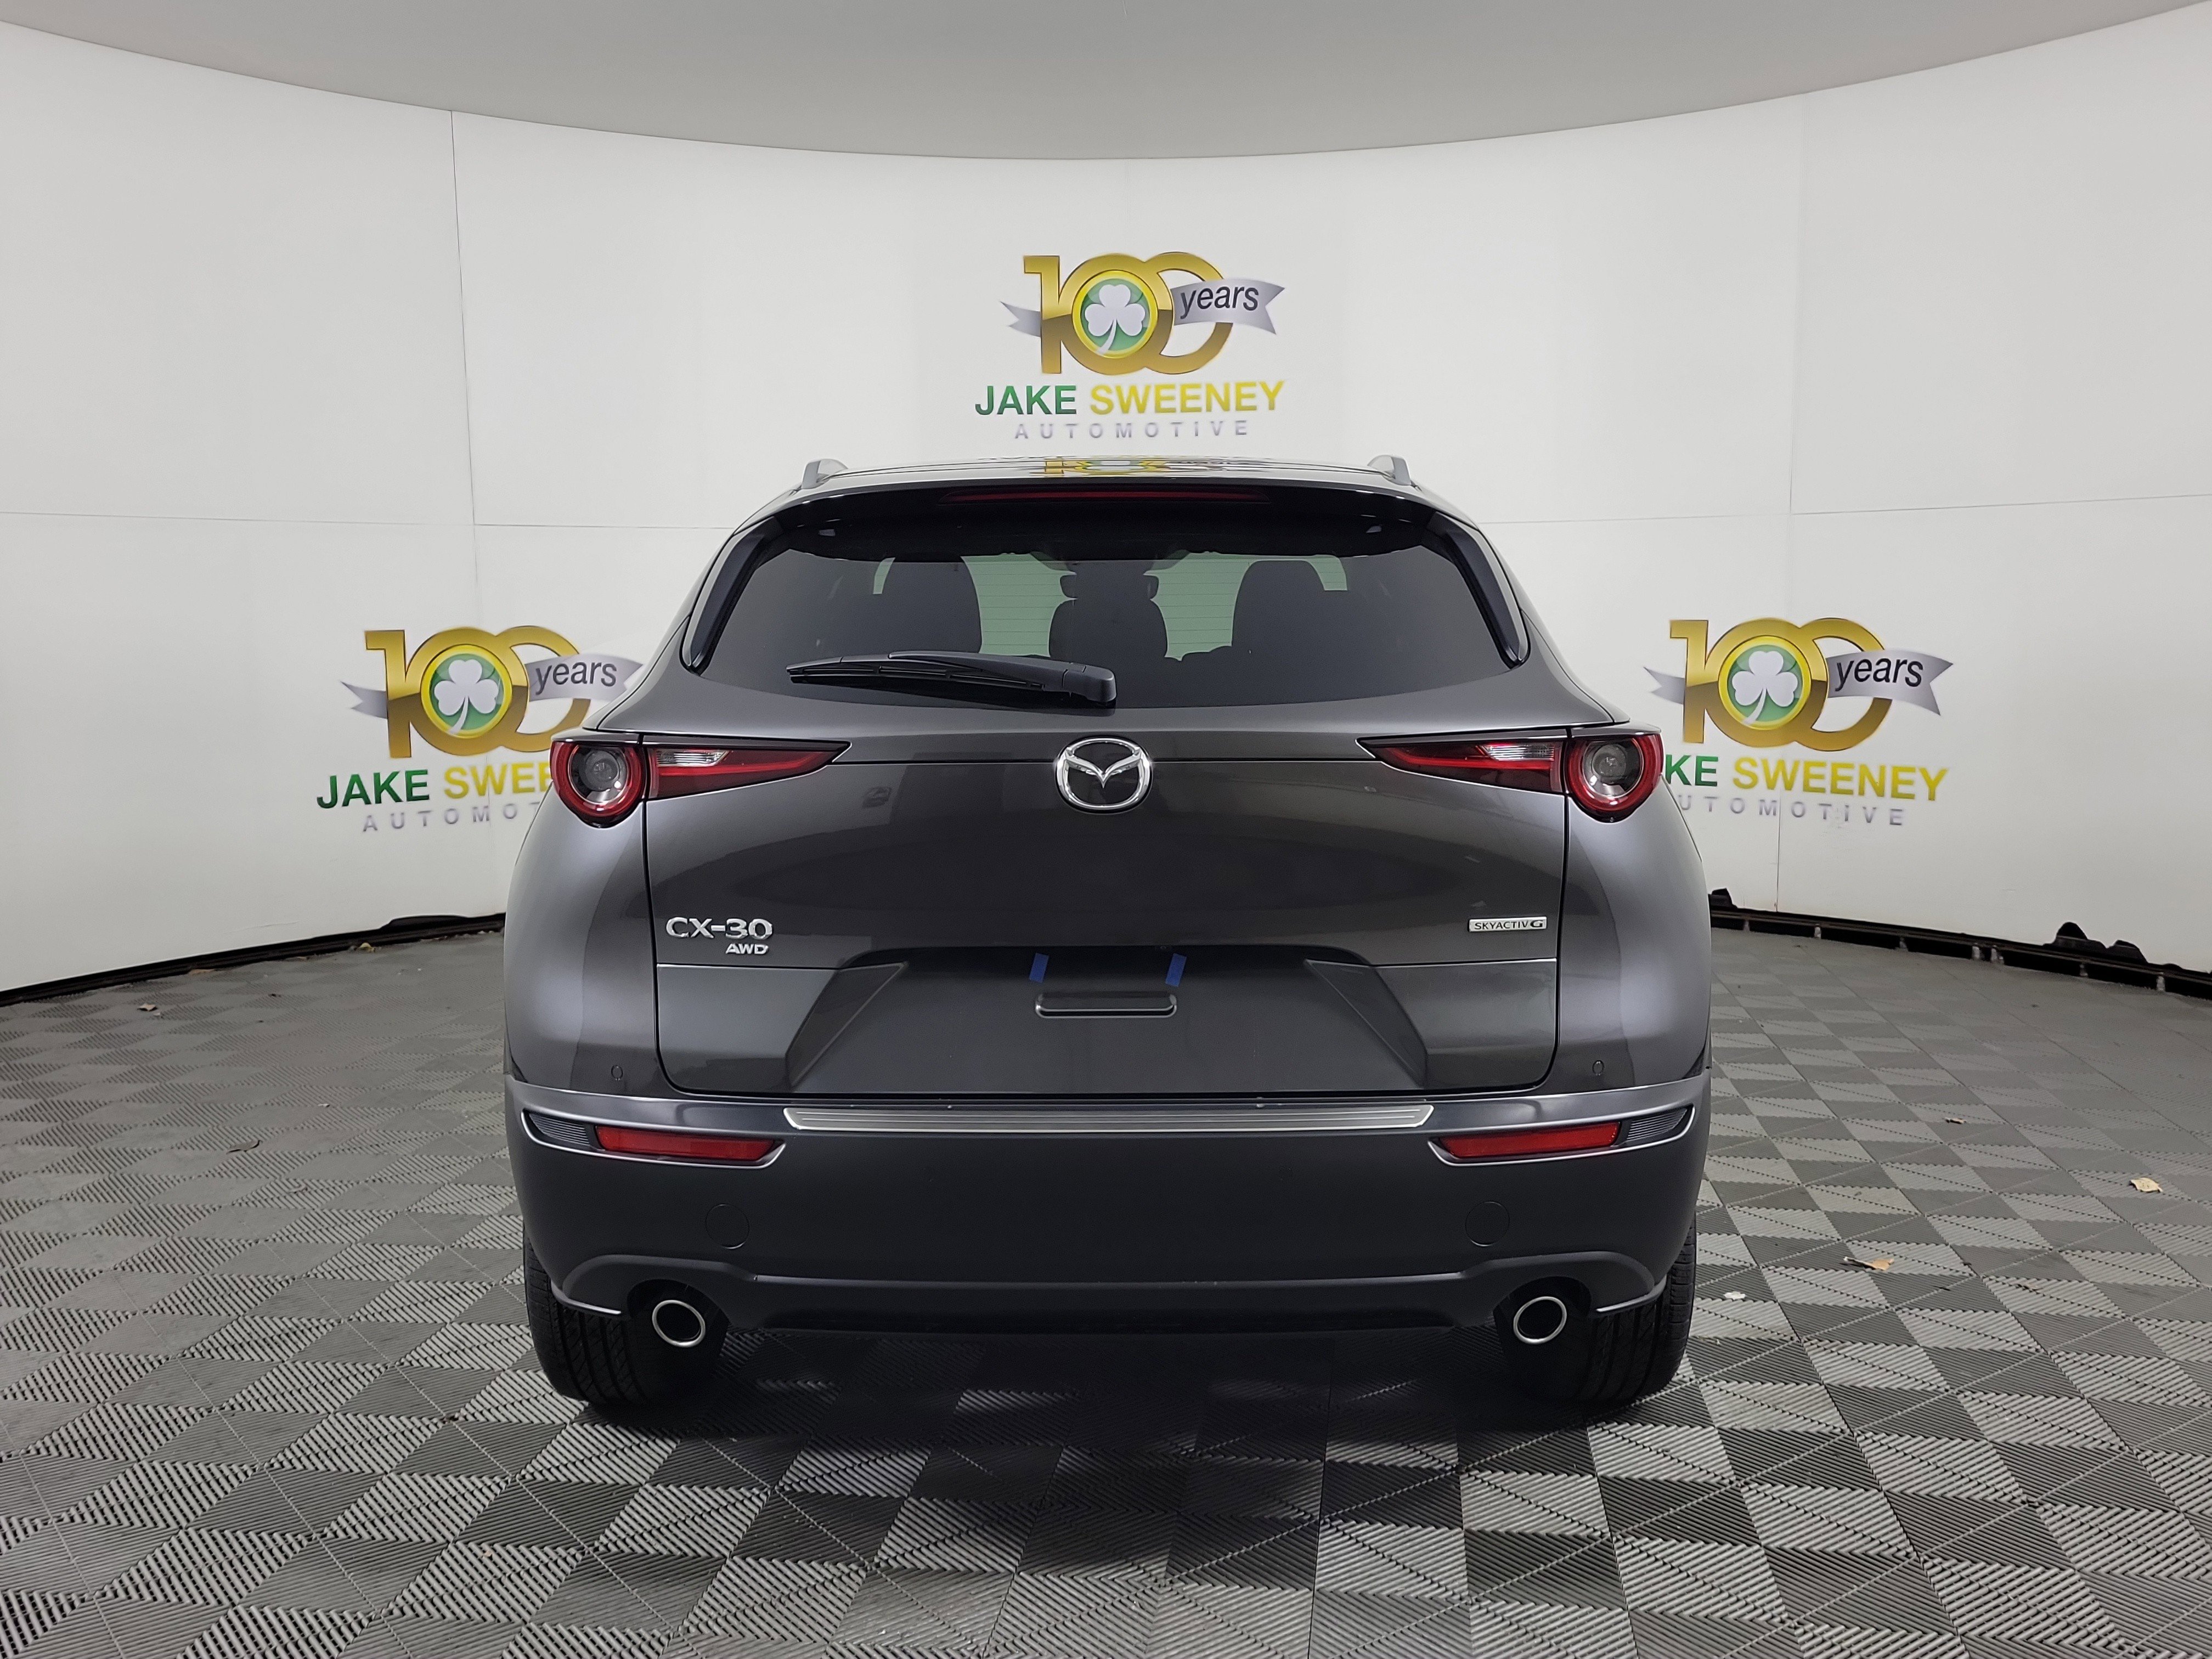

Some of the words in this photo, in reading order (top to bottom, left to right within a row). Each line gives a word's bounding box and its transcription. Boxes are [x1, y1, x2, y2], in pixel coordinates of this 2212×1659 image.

[1023, 251, 1233, 375] 100
[1180, 284, 1260, 319] years
[975, 385, 1077, 415] JAKE
[1090, 381, 1285, 415] SWEENEY
[1014, 420, 1248, 439] AUTOMOTIVE
[535, 662, 617, 695] years
[1669, 617, 1892, 752] 100
[1835, 658, 1923, 691] years
[317, 770, 430, 809] JAKE
[1665, 754, 1718, 787] KE
[1733, 757, 1948, 802] SWEENEY
[1678, 794, 1904, 826] UTOMOTIVE
[665, 917, 772, 940] CX-30
[725, 943, 769, 955] AWD
